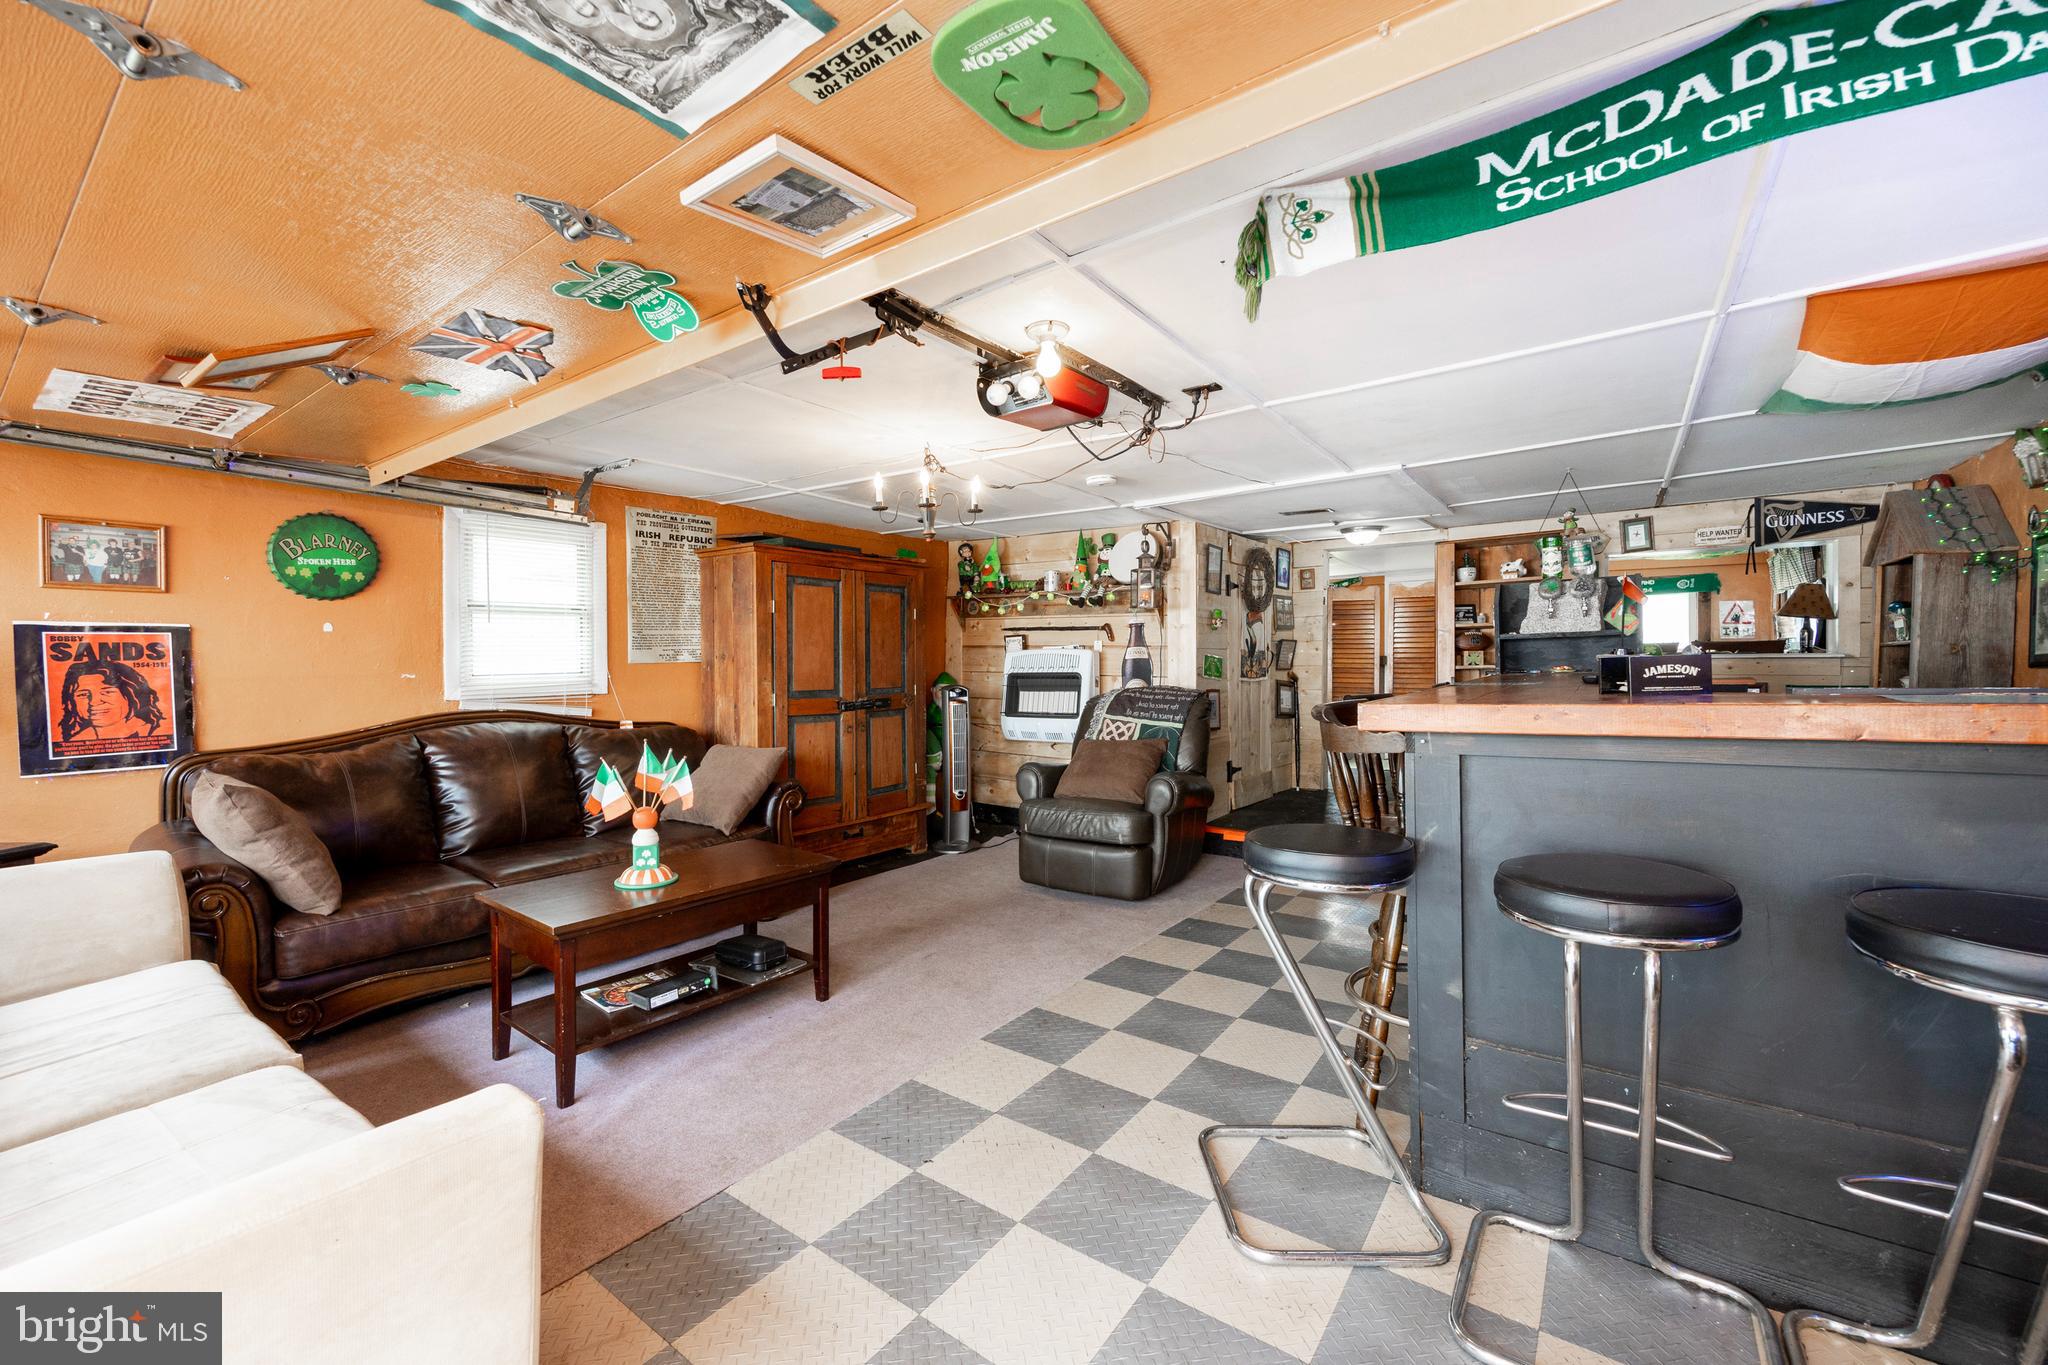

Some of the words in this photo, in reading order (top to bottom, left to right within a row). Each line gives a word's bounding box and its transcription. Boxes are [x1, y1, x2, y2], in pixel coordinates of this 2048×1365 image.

[804, 23, 898, 84] BEER
[884, 30, 922, 57] WILL
[960, 16, 1057, 72] JAMESON
[840, 53, 885, 84] WORK
[813, 79, 842, 100] FOR
[1495, 136, 1688, 212] SCHOOL
[1702, 102, 1766, 142] OF
[1780, 60, 1936, 119] IRISH
[1765, 510, 1845, 528] GUINNESS
[635, 529, 661, 540] IRISH
[669, 533, 713, 545] REPUBLIC
[1697, 530, 1714, 538] HELP
[1715, 528, 1743, 537] WANTED
[278, 532, 371, 560] BLARNEY
[297, 556, 332, 566] SPOKEN
[333, 558, 357, 566] HERE
[49, 641, 166, 661] SANDS
[1642, 664, 1700, 679] JAMESON
